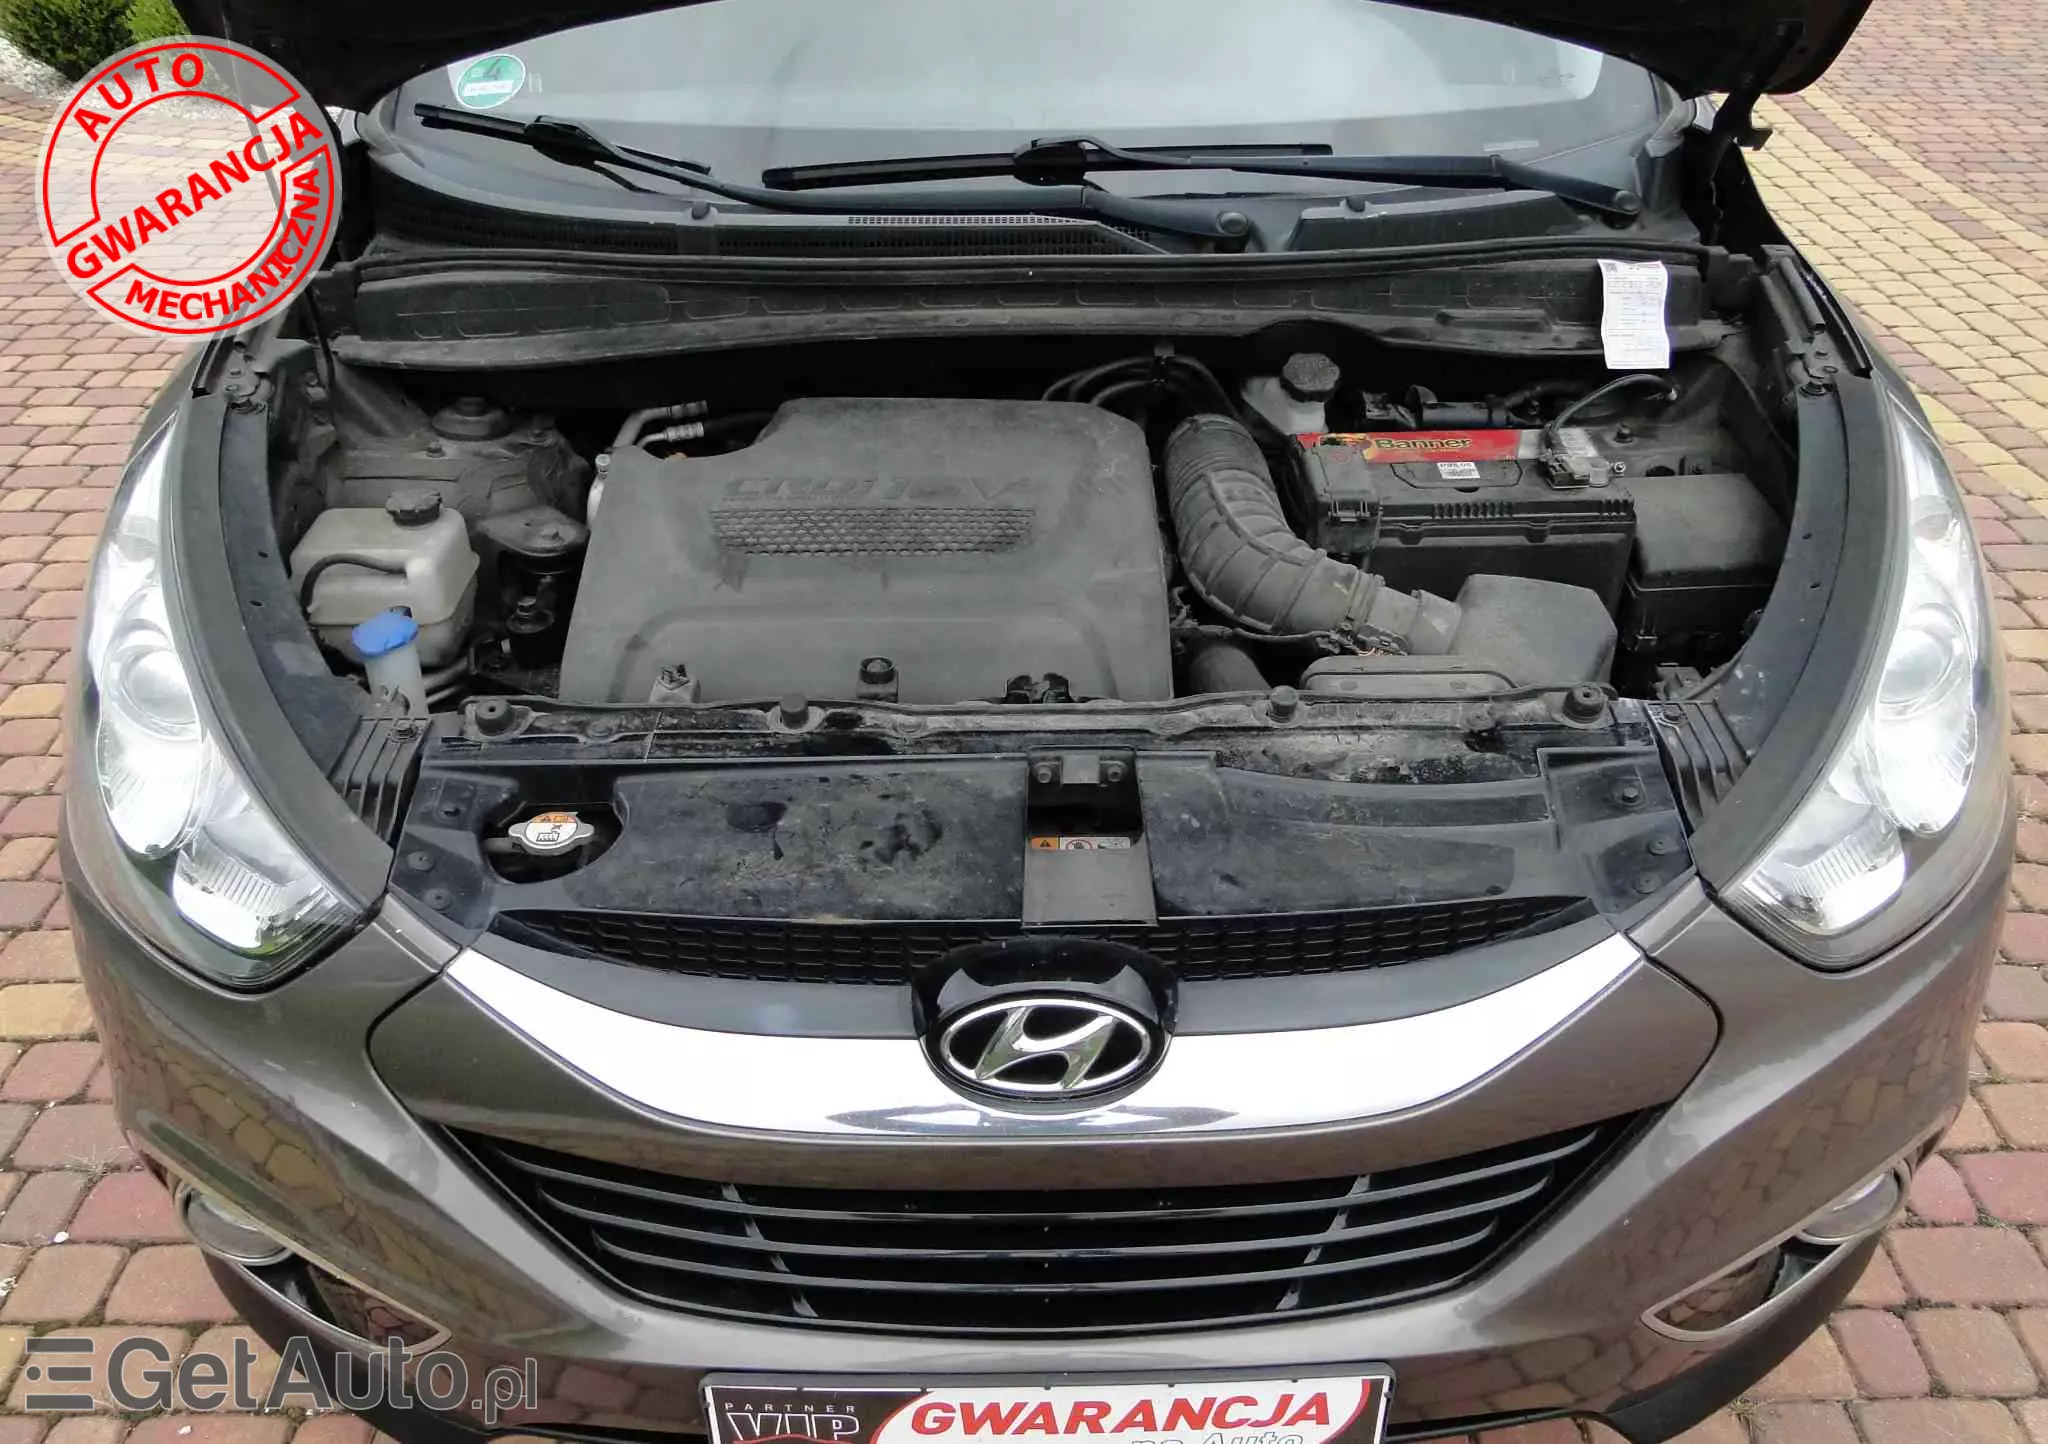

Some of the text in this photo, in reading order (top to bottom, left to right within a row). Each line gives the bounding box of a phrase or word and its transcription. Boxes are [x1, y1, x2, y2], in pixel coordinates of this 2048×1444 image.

[1374, 438, 1472, 450] Banner
[724, 1402, 857, 1413] PARTNER
[911, 1393, 1330, 1435] GWARANCJA
[726, 1412, 860, 1443] VIP
